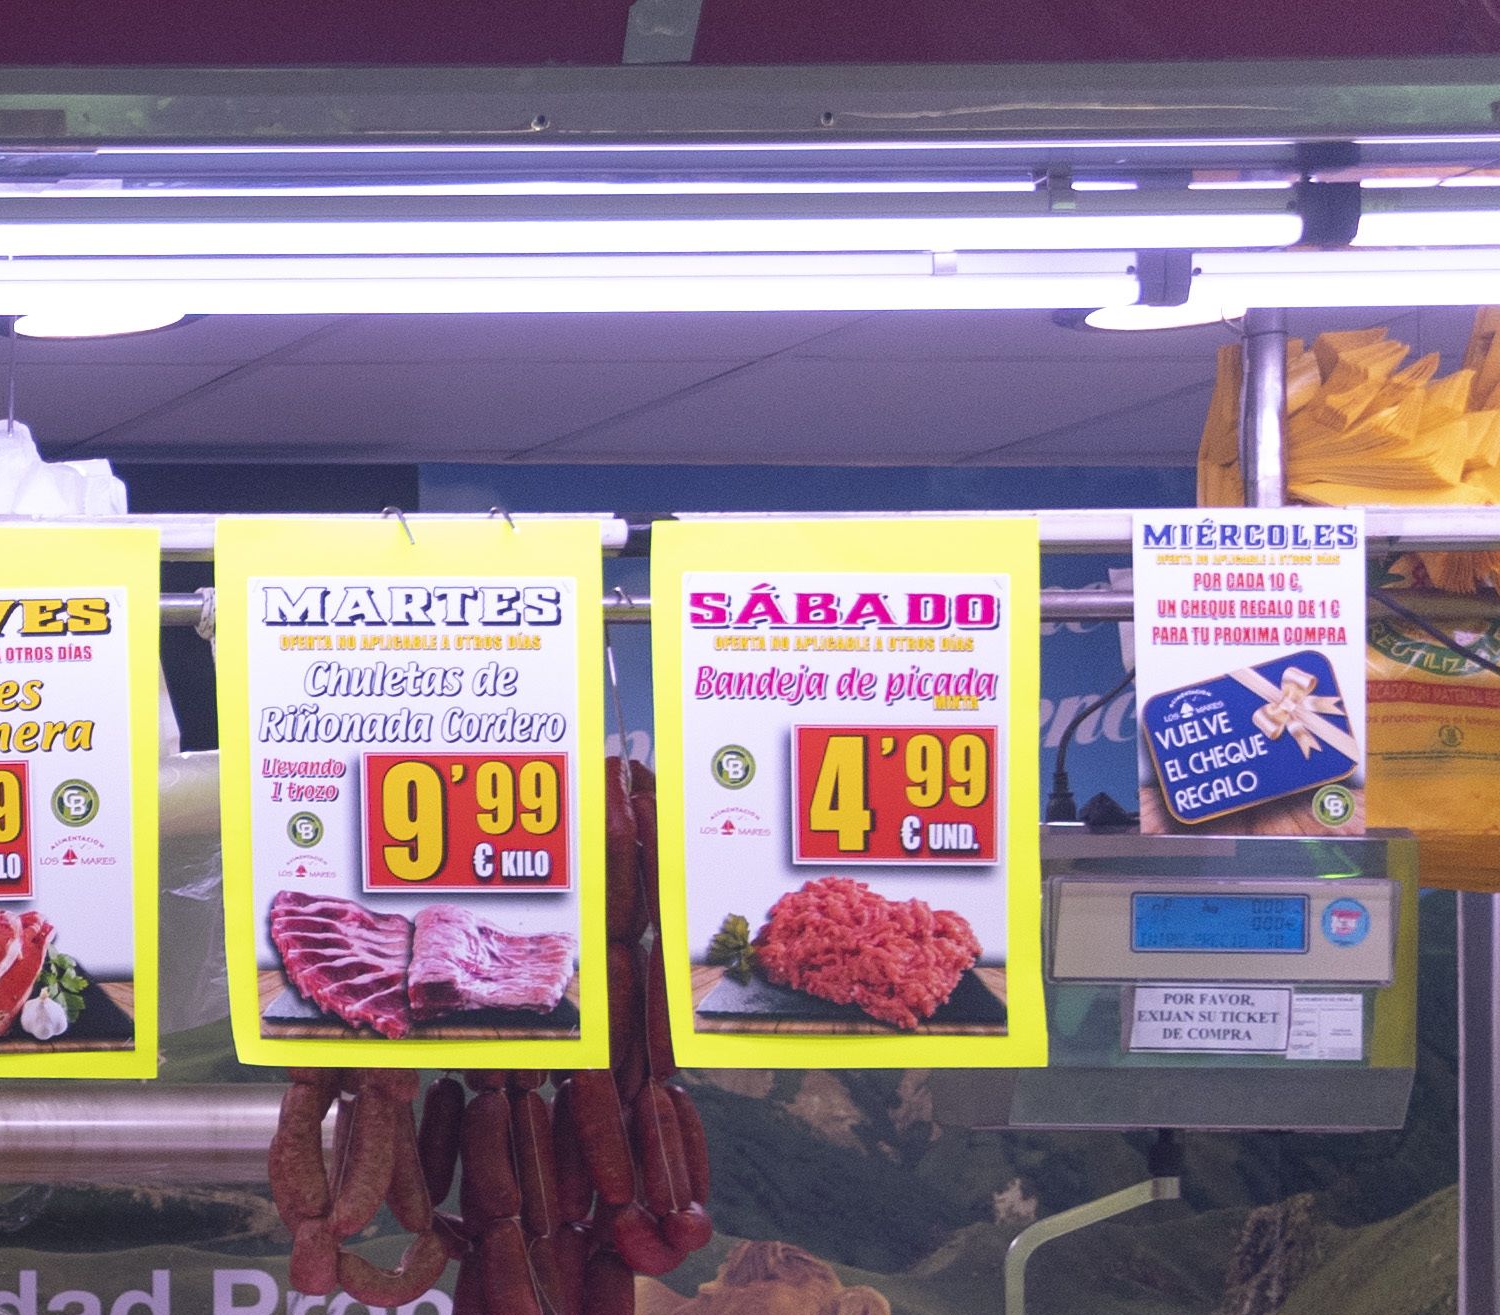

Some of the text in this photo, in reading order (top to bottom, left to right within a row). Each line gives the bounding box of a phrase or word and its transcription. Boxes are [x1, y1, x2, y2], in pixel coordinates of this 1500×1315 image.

[1143, 518, 1358, 549] MIÉRCOLES
[1194, 573, 1223, 592] POR
[1226, 572, 1266, 592] CADA
[1269, 573, 1284, 591] 10
[261, 585, 562, 628] MARTES
[689, 583, 1000, 629] SÁBADO
[5, 646, 54, 663] OTROS
[58, 643, 93, 663] DÍAS
[304, 661, 518, 698] Chuletas de
[694, 664, 999, 703] Bandeja de picada
[259, 705, 566, 744] Riñonada Cordero
[1155, 711, 1232, 751] VUELVE
[1165, 733, 1268, 783] EL CHEQUE
[1174, 770, 1258, 812] REGALO
[901, 815, 981, 852] € UND.
[472, 842, 551, 879] € KILO
